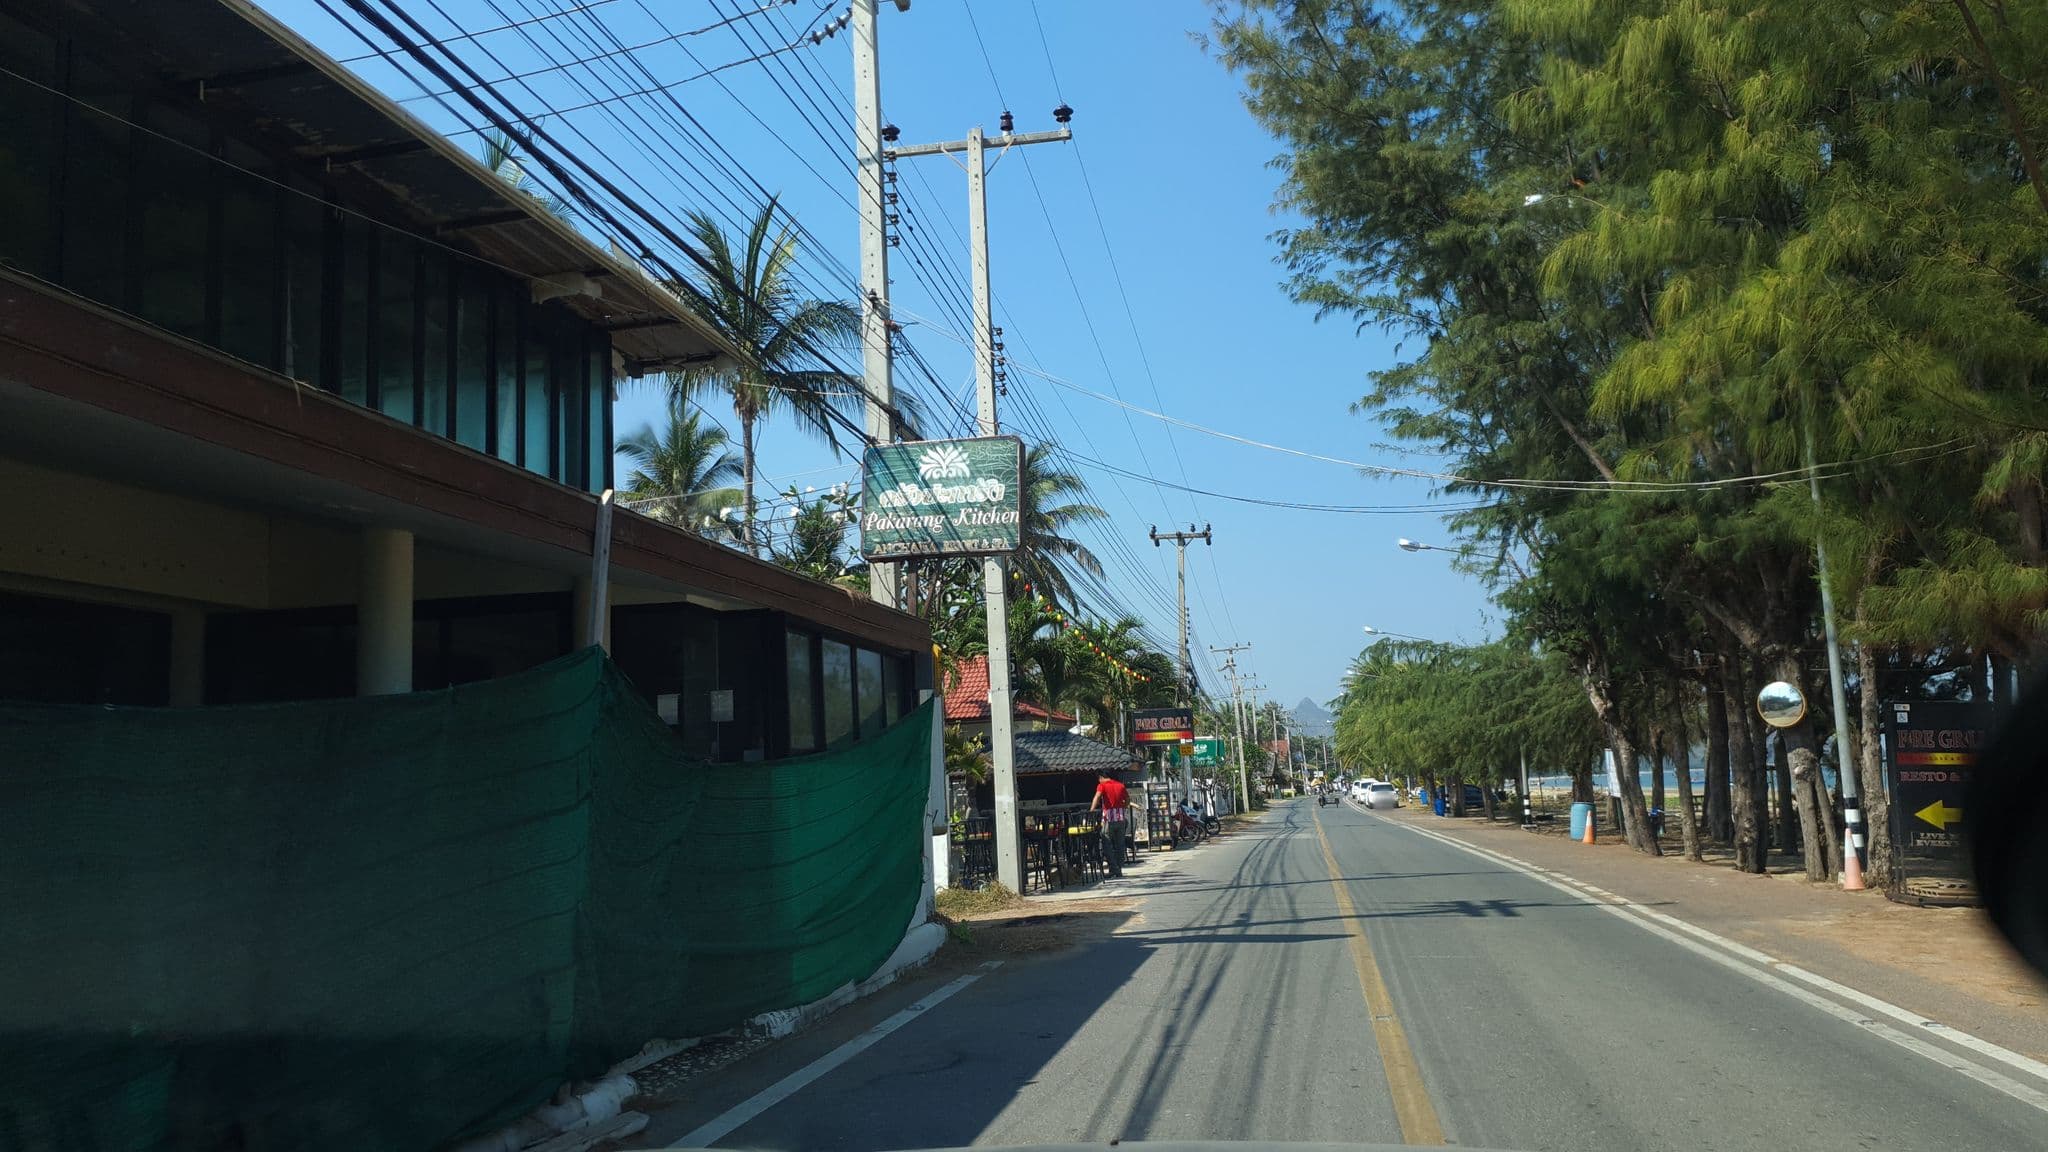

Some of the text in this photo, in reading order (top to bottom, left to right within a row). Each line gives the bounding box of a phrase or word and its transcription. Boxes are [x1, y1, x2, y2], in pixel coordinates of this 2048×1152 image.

[865, 506, 1019, 533] Pakarang Kitchen
[1896, 729, 1935, 749] FIRE
[1899, 771, 1948, 783] RESTO
